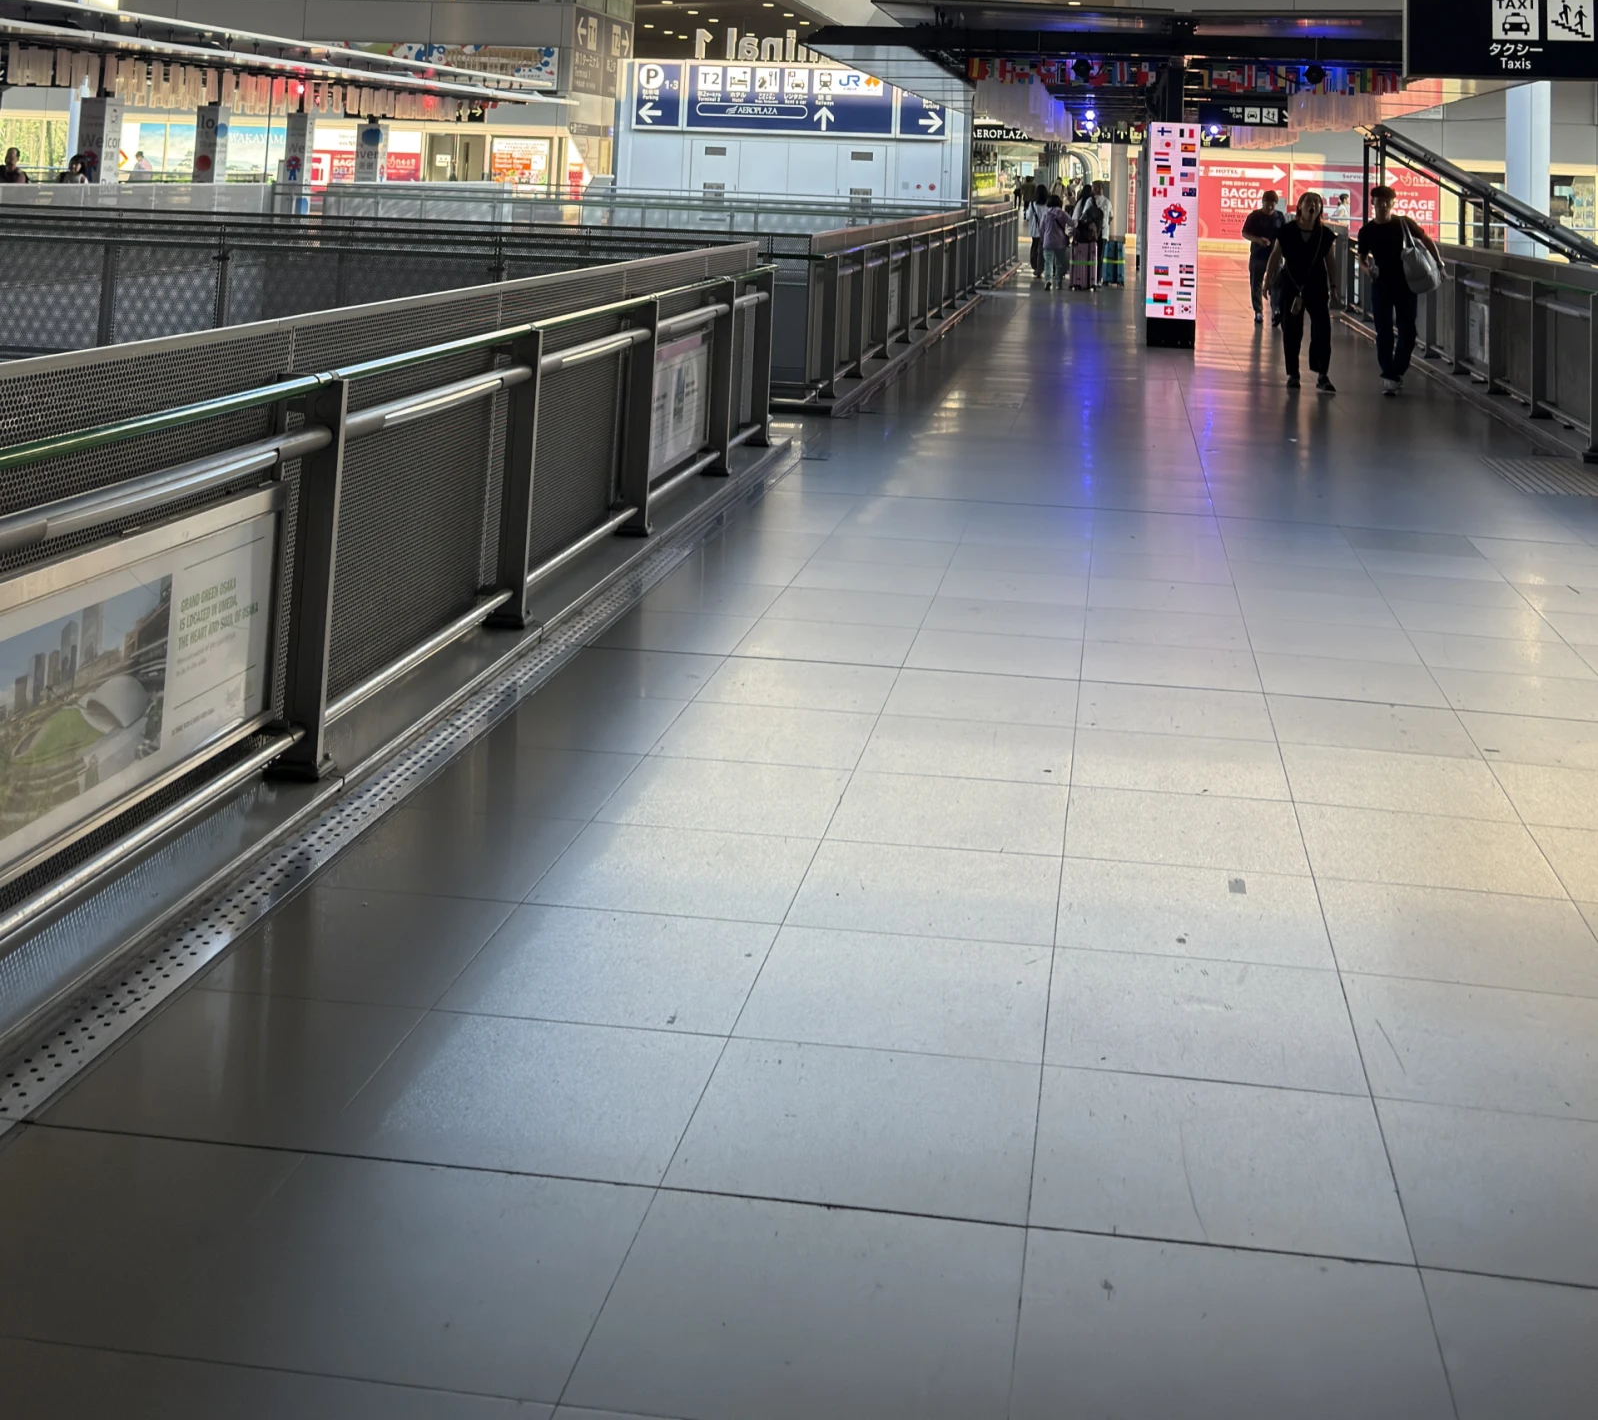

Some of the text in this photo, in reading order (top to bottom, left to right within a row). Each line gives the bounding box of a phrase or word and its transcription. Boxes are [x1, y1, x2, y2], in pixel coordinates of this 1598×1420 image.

[588, 25, 597, 45] T1
[1489, 43, 1544, 56] タクシー
[1500, 58, 1532, 70] Taxis
[646, 68, 660, 85] P
[701, 71, 720, 85] T2
[839, 75, 860, 87] JR
[1221, 187, 1283, 199] BAGGAE
